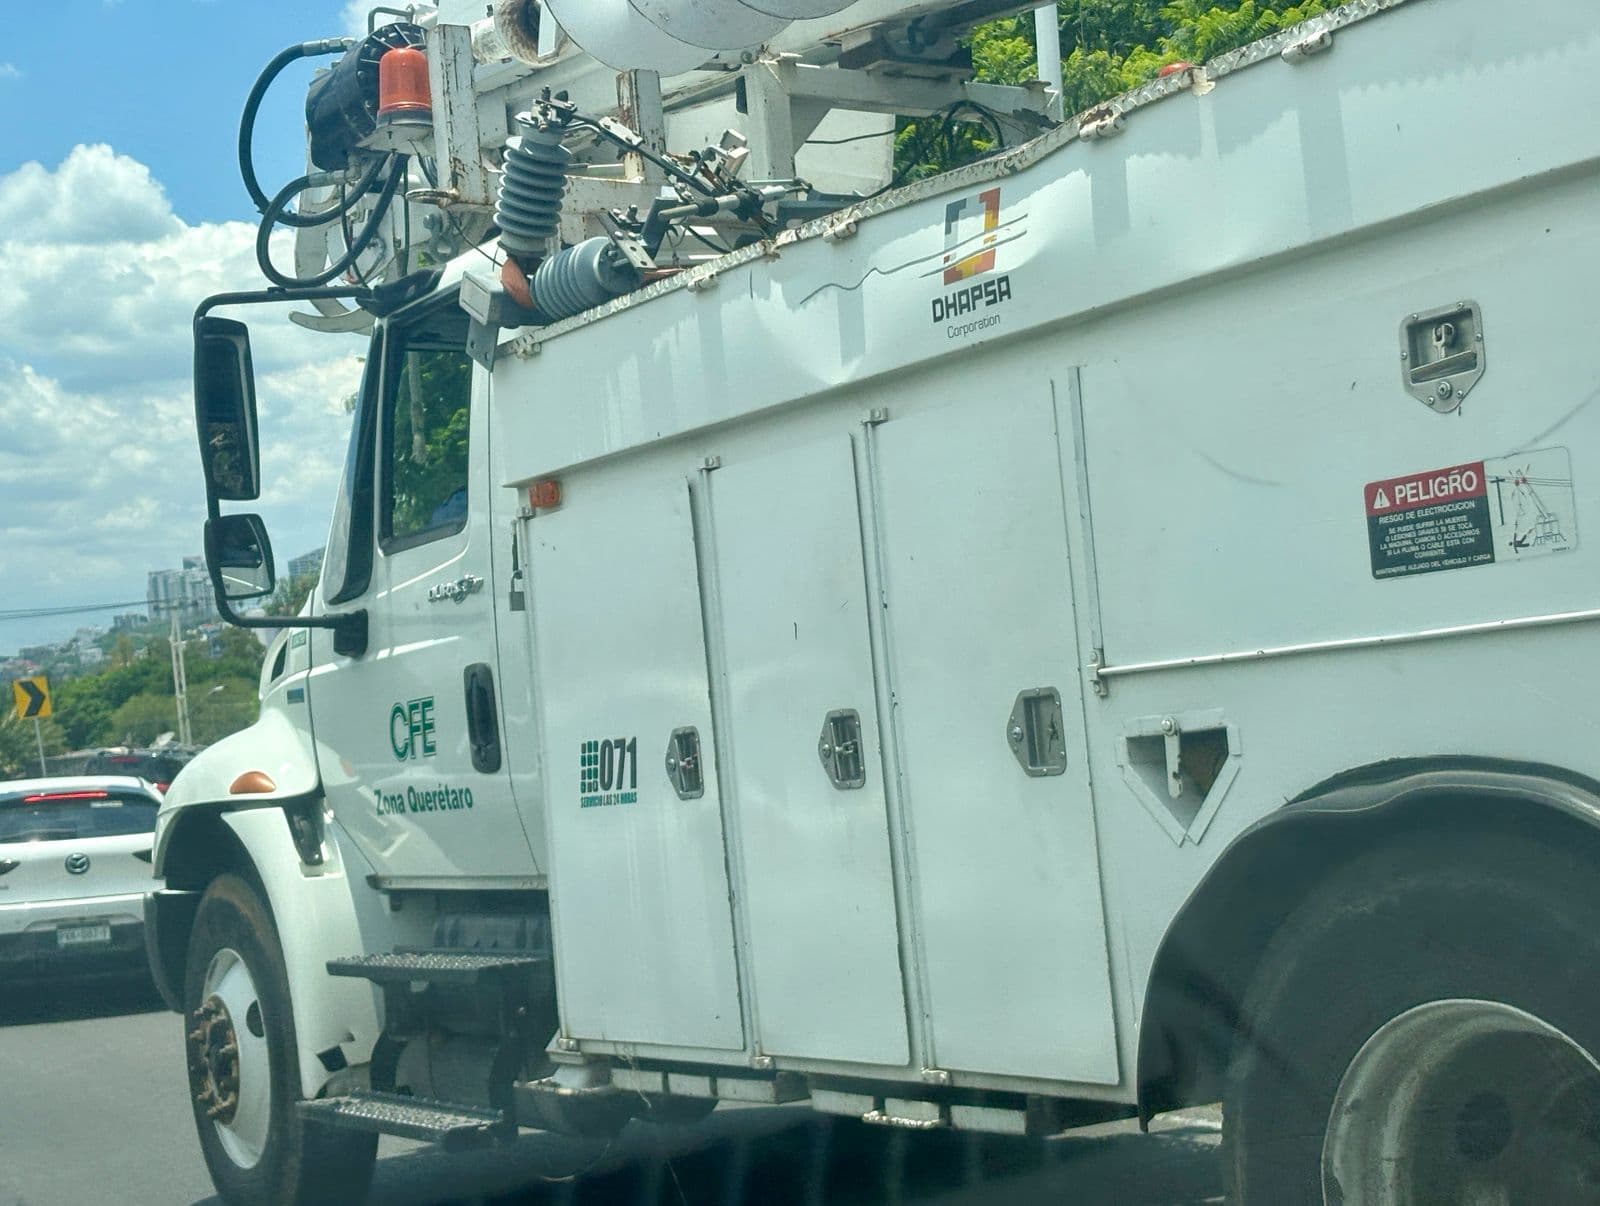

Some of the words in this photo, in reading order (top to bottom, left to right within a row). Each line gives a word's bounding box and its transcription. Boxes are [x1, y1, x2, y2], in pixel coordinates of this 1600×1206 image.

[932, 275, 1012, 323] DHAPSA
[947, 313, 1001, 339] Corporation
[1394, 470, 1478, 505] PELIGRO
[1379, 512, 1404, 525] RIESGO
[1405, 510, 1416, 520] DE
[1385, 535, 1391, 543] O
[1447, 524, 1456, 532] SE
[1456, 521, 1473, 530] TOCA
[390, 696, 437, 762] CFE
[599, 736, 637, 791] 071
[374, 788, 406, 816] Zona
[407, 782, 474, 813] Querétaro
[603, 794, 613, 806] LAS
[613, 793, 620, 806] 24
